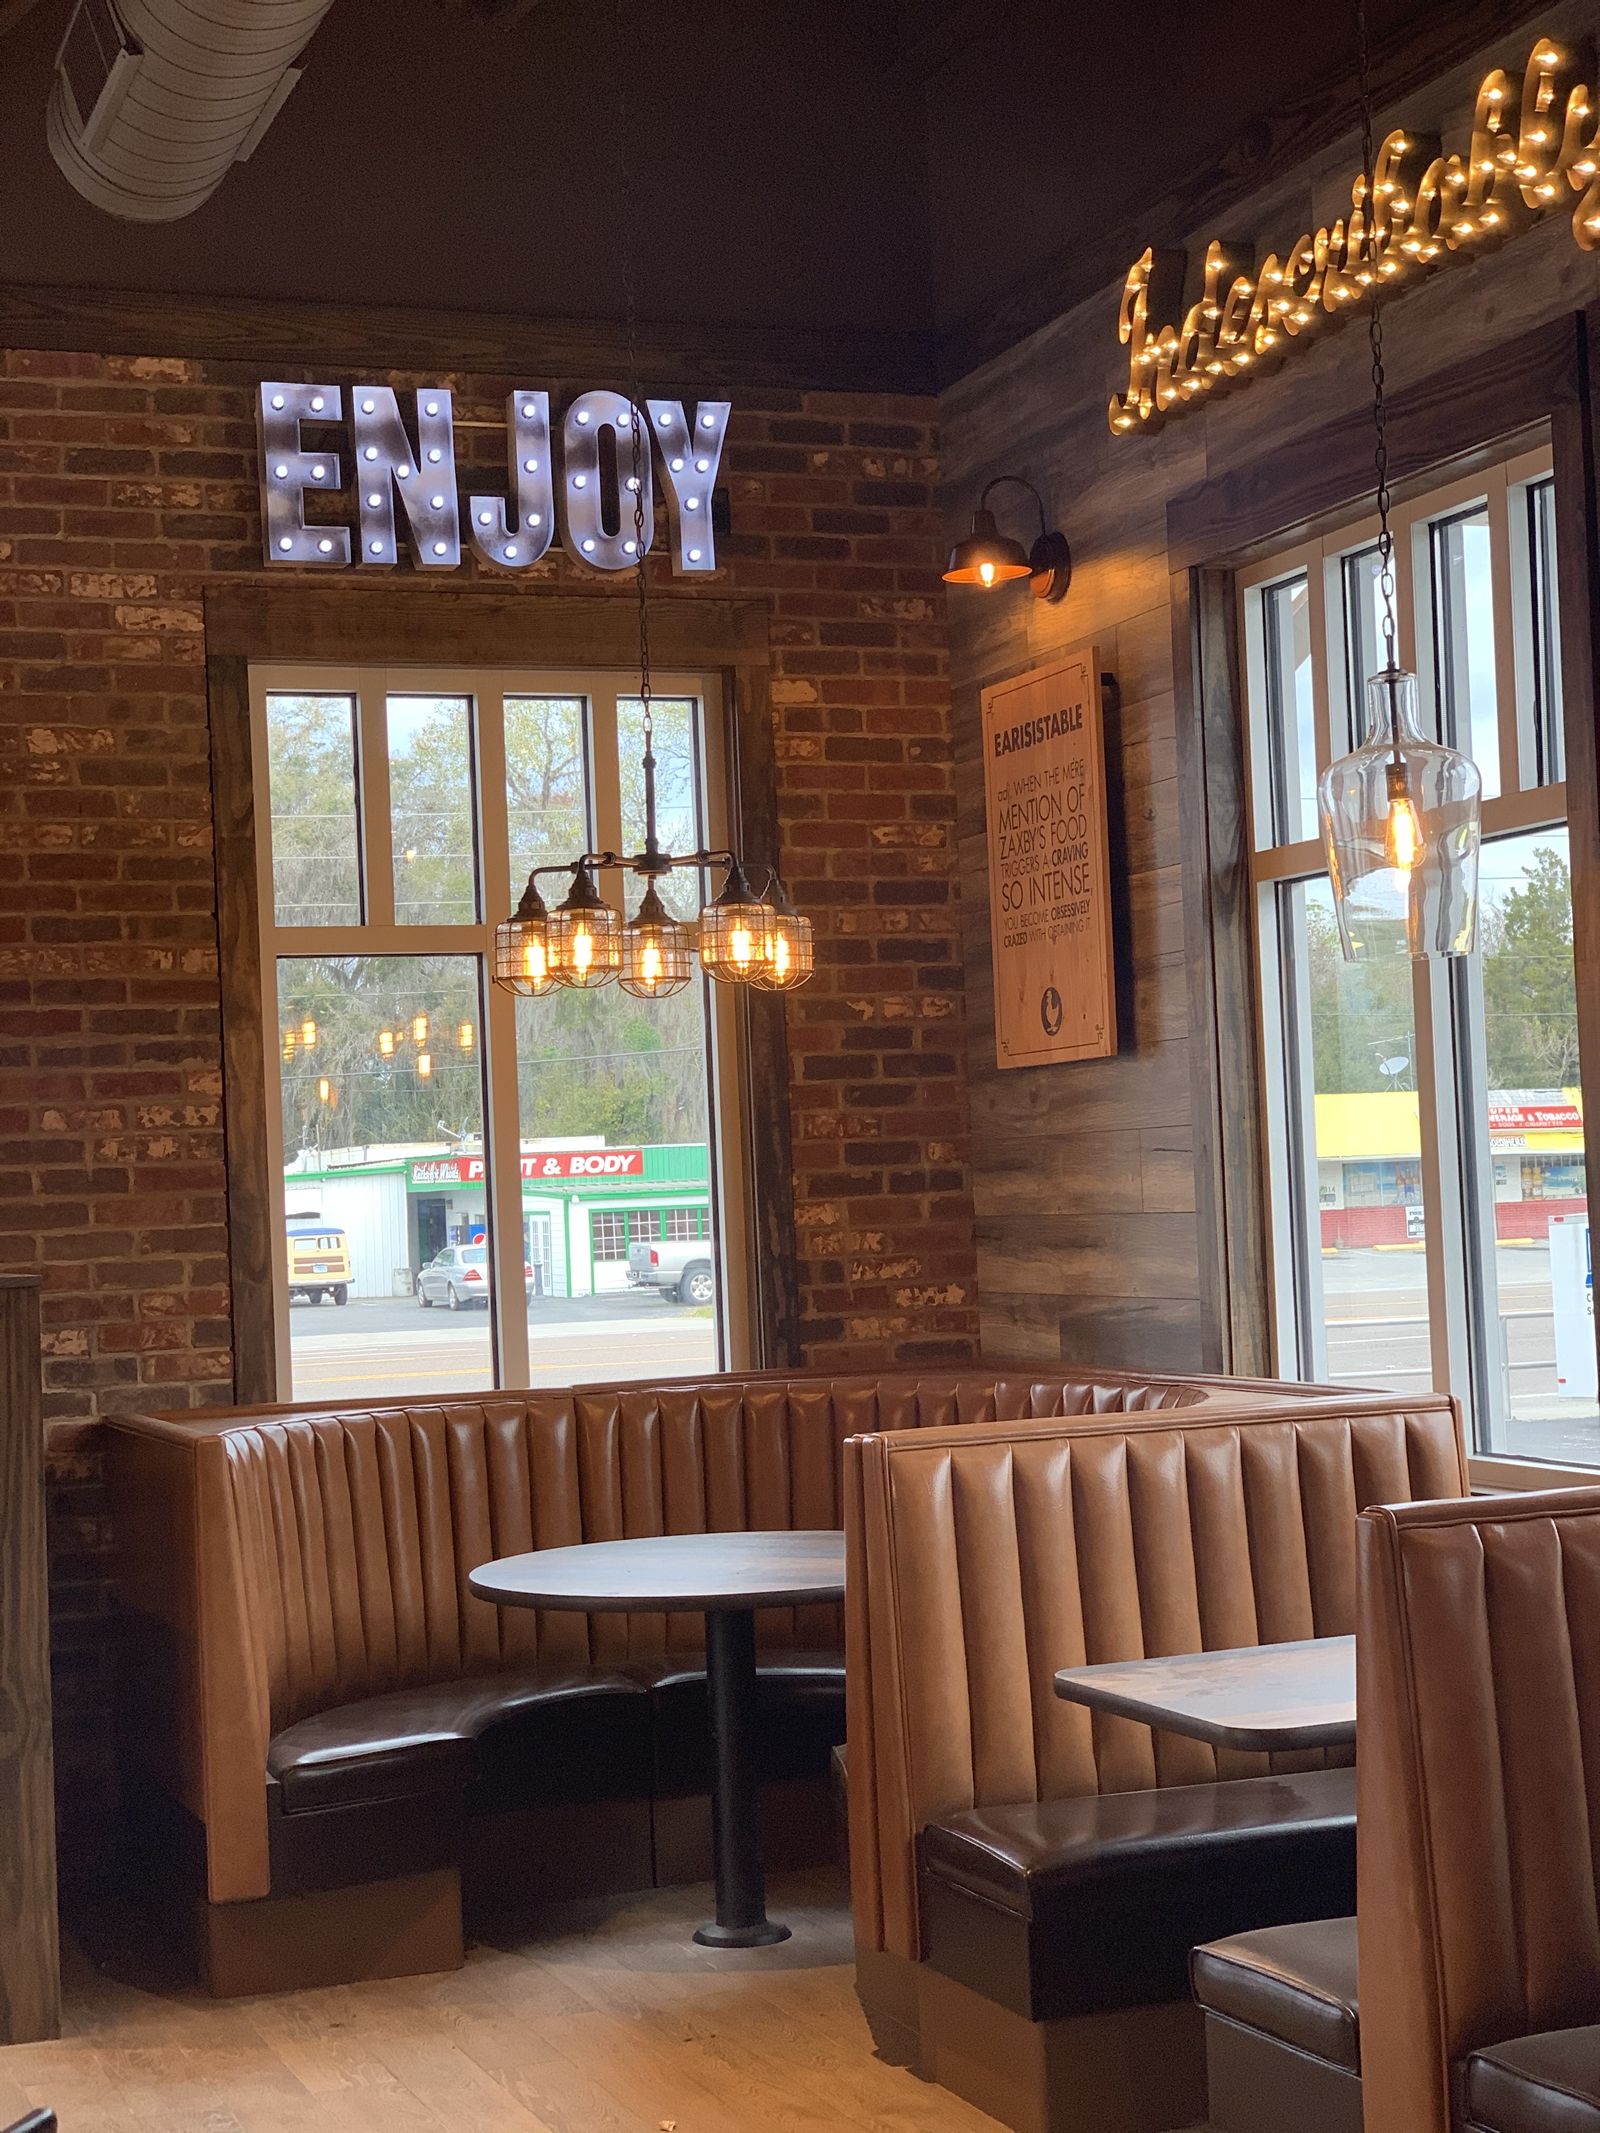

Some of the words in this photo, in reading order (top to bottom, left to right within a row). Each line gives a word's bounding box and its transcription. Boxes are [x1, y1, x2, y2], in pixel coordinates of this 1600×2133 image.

[259, 381, 732, 577] ENJOY
[994, 703, 1083, 757] EARISISTABLE
[1013, 773, 1041, 796] WHEN
[1043, 767, 1060, 787] THE
[999, 790, 1062, 833] MENTION
[1067, 783, 1085, 813] OF
[999, 825, 1047, 860] ZAXBY'S
[1050, 814, 1087, 846] FOOD
[1000, 854, 1040, 878] TRIGGERS
[1042, 853, 1050, 869] A
[1051, 841, 1089, 867] CRAVING
[1002, 880, 1024, 913] SO
[1004, 916, 1019, 931] YOU
[1020, 908, 1049, 928] BECOME
[1050, 899, 1090, 921] OBSESSIVELY
[1003, 931, 1028, 948] CRAZED
[1029, 928, 1047, 942] WITH
[542, 1157, 562, 1175] &
[570, 1154, 637, 1175] BODY
